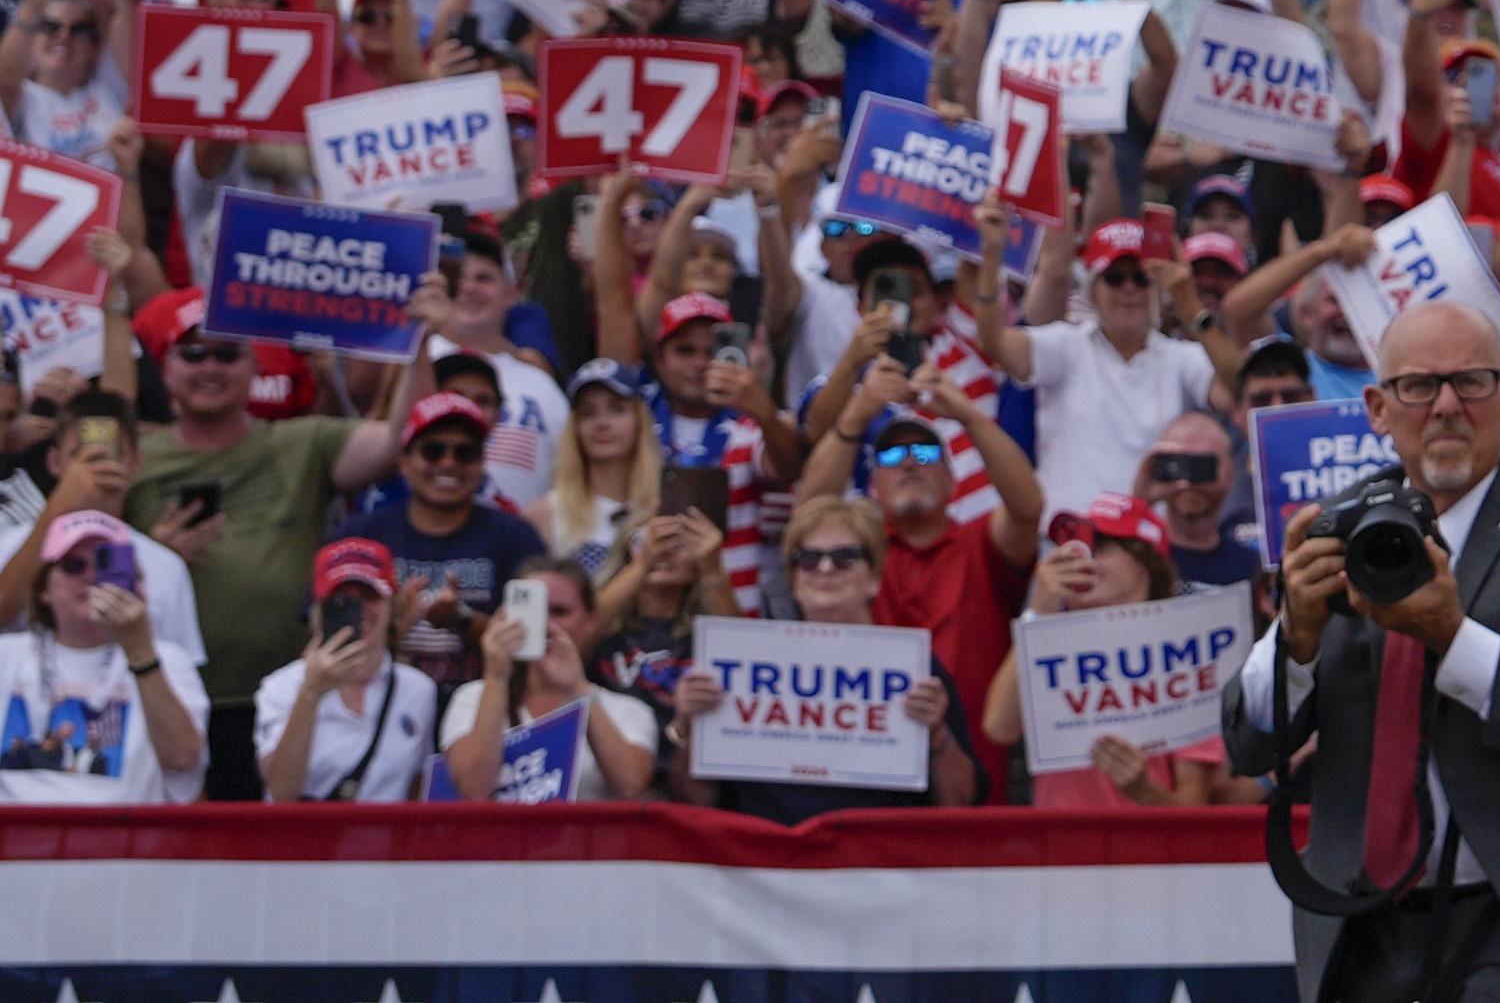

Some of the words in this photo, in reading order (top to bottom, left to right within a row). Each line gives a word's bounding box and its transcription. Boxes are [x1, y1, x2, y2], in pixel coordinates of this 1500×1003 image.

[1001, 31, 1124, 63] TRUMP
[1201, 39, 1333, 94] TRUM
[150, 23, 313, 122] 47
[555, 54, 721, 158] 47
[1210, 74, 1330, 121] VANCE
[325, 110, 490, 164] TRUMP
[902, 130, 990, 178] PEAC
[347, 143, 475, 190] VANCE
[266, 229, 387, 270] PEACE
[233, 251, 411, 300] THROUGH
[224, 282, 410, 328] STRENGTH
[711, 659, 911, 701] TRUMP
[1035, 627, 1237, 689] TRUMP
[1064, 663, 1220, 715] VANCE
[735, 698, 889, 731] VANCE
